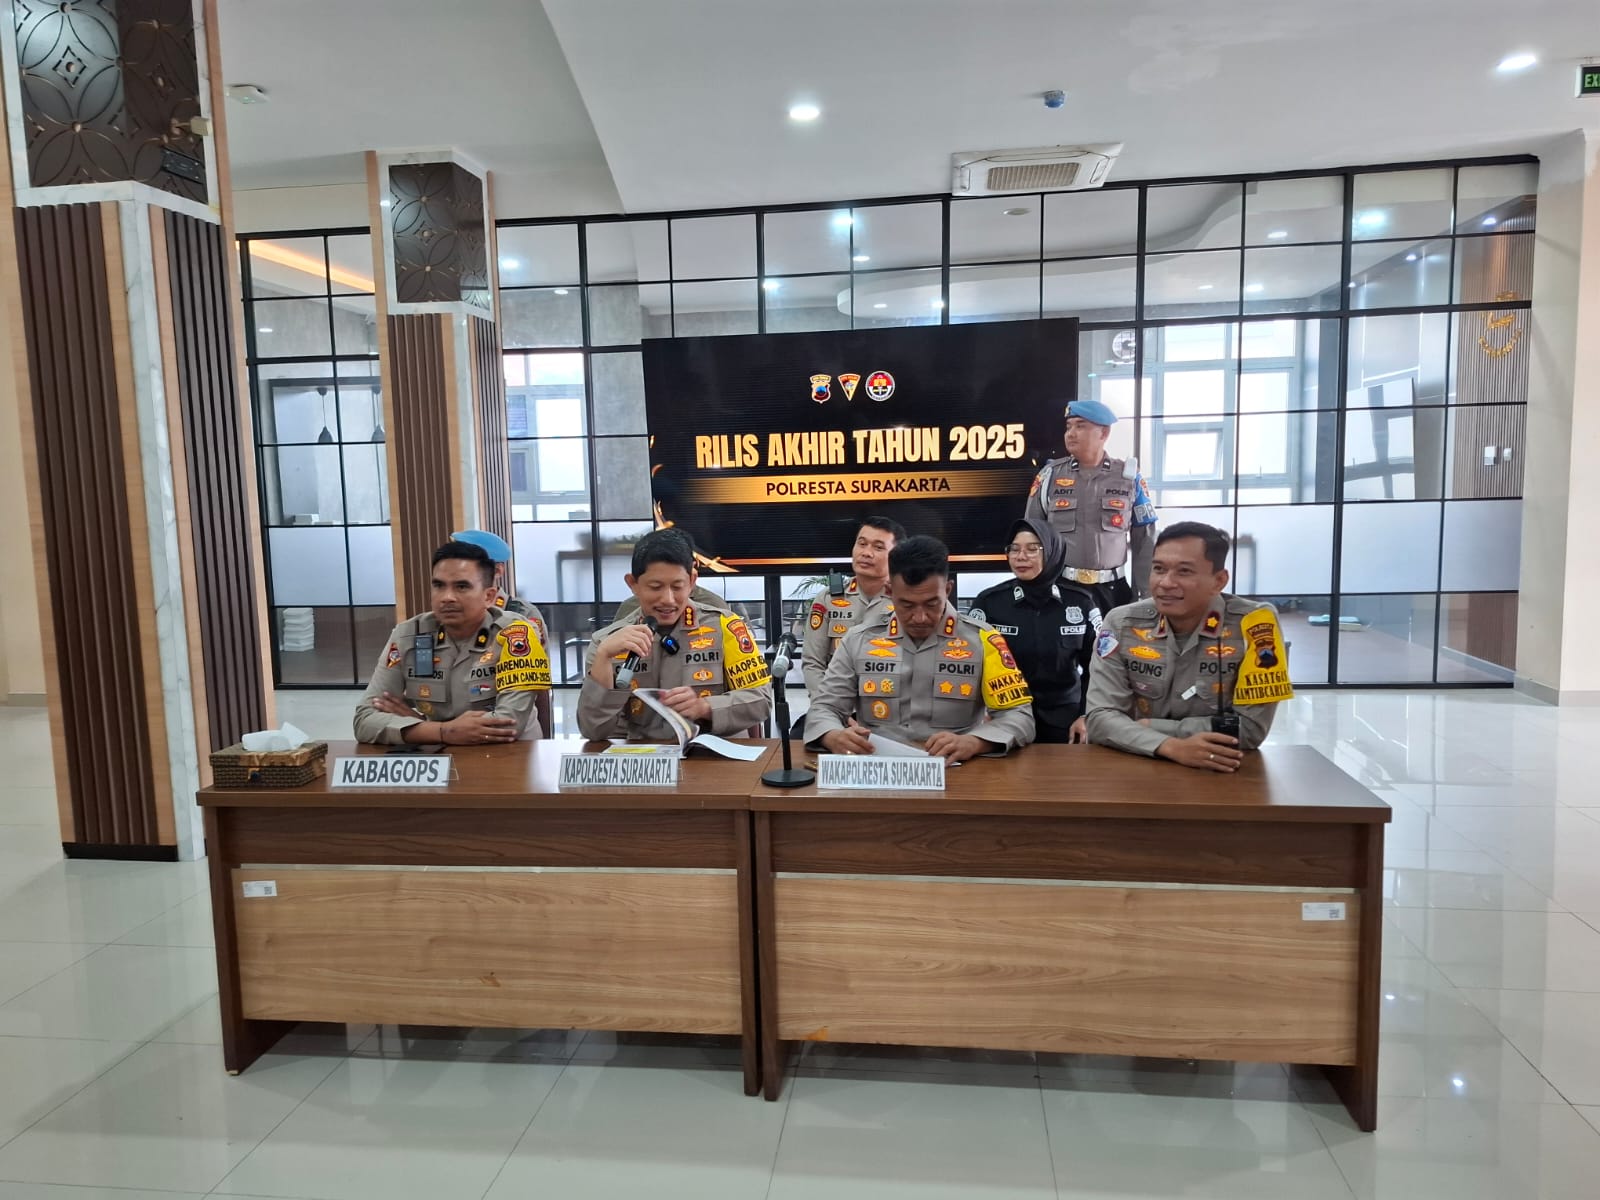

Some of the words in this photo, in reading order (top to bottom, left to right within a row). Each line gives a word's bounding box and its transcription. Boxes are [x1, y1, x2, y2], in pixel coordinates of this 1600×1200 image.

[695, 433, 760, 469] RILIS
[767, 431, 846, 467] AKHIR
[852, 427, 940, 464] TAHUN
[949, 423, 1025, 461] 2025
[766, 480, 847, 496] POLRESTA
[851, 478, 950, 493] SURAKARTA
[1105, 488, 1129, 496] POLRI
[685, 651, 719, 663] POLRI
[471, 666, 496, 679] POLR
[727, 657, 757, 676] KAOPS
[865, 662, 897, 672] SIGIT
[938, 663, 975, 675] POLRI
[1199, 662, 1237, 674] POLR
[988, 675, 1015, 691] WAKA
[342, 759, 440, 783] KABAGOPS
[564, 758, 618, 783] KAPOLRESTA
[620, 758, 672, 783] SURAKARTA
[821, 760, 889, 785] WAKAPOLRESTA
[891, 761, 943, 787] SURAKARTA
